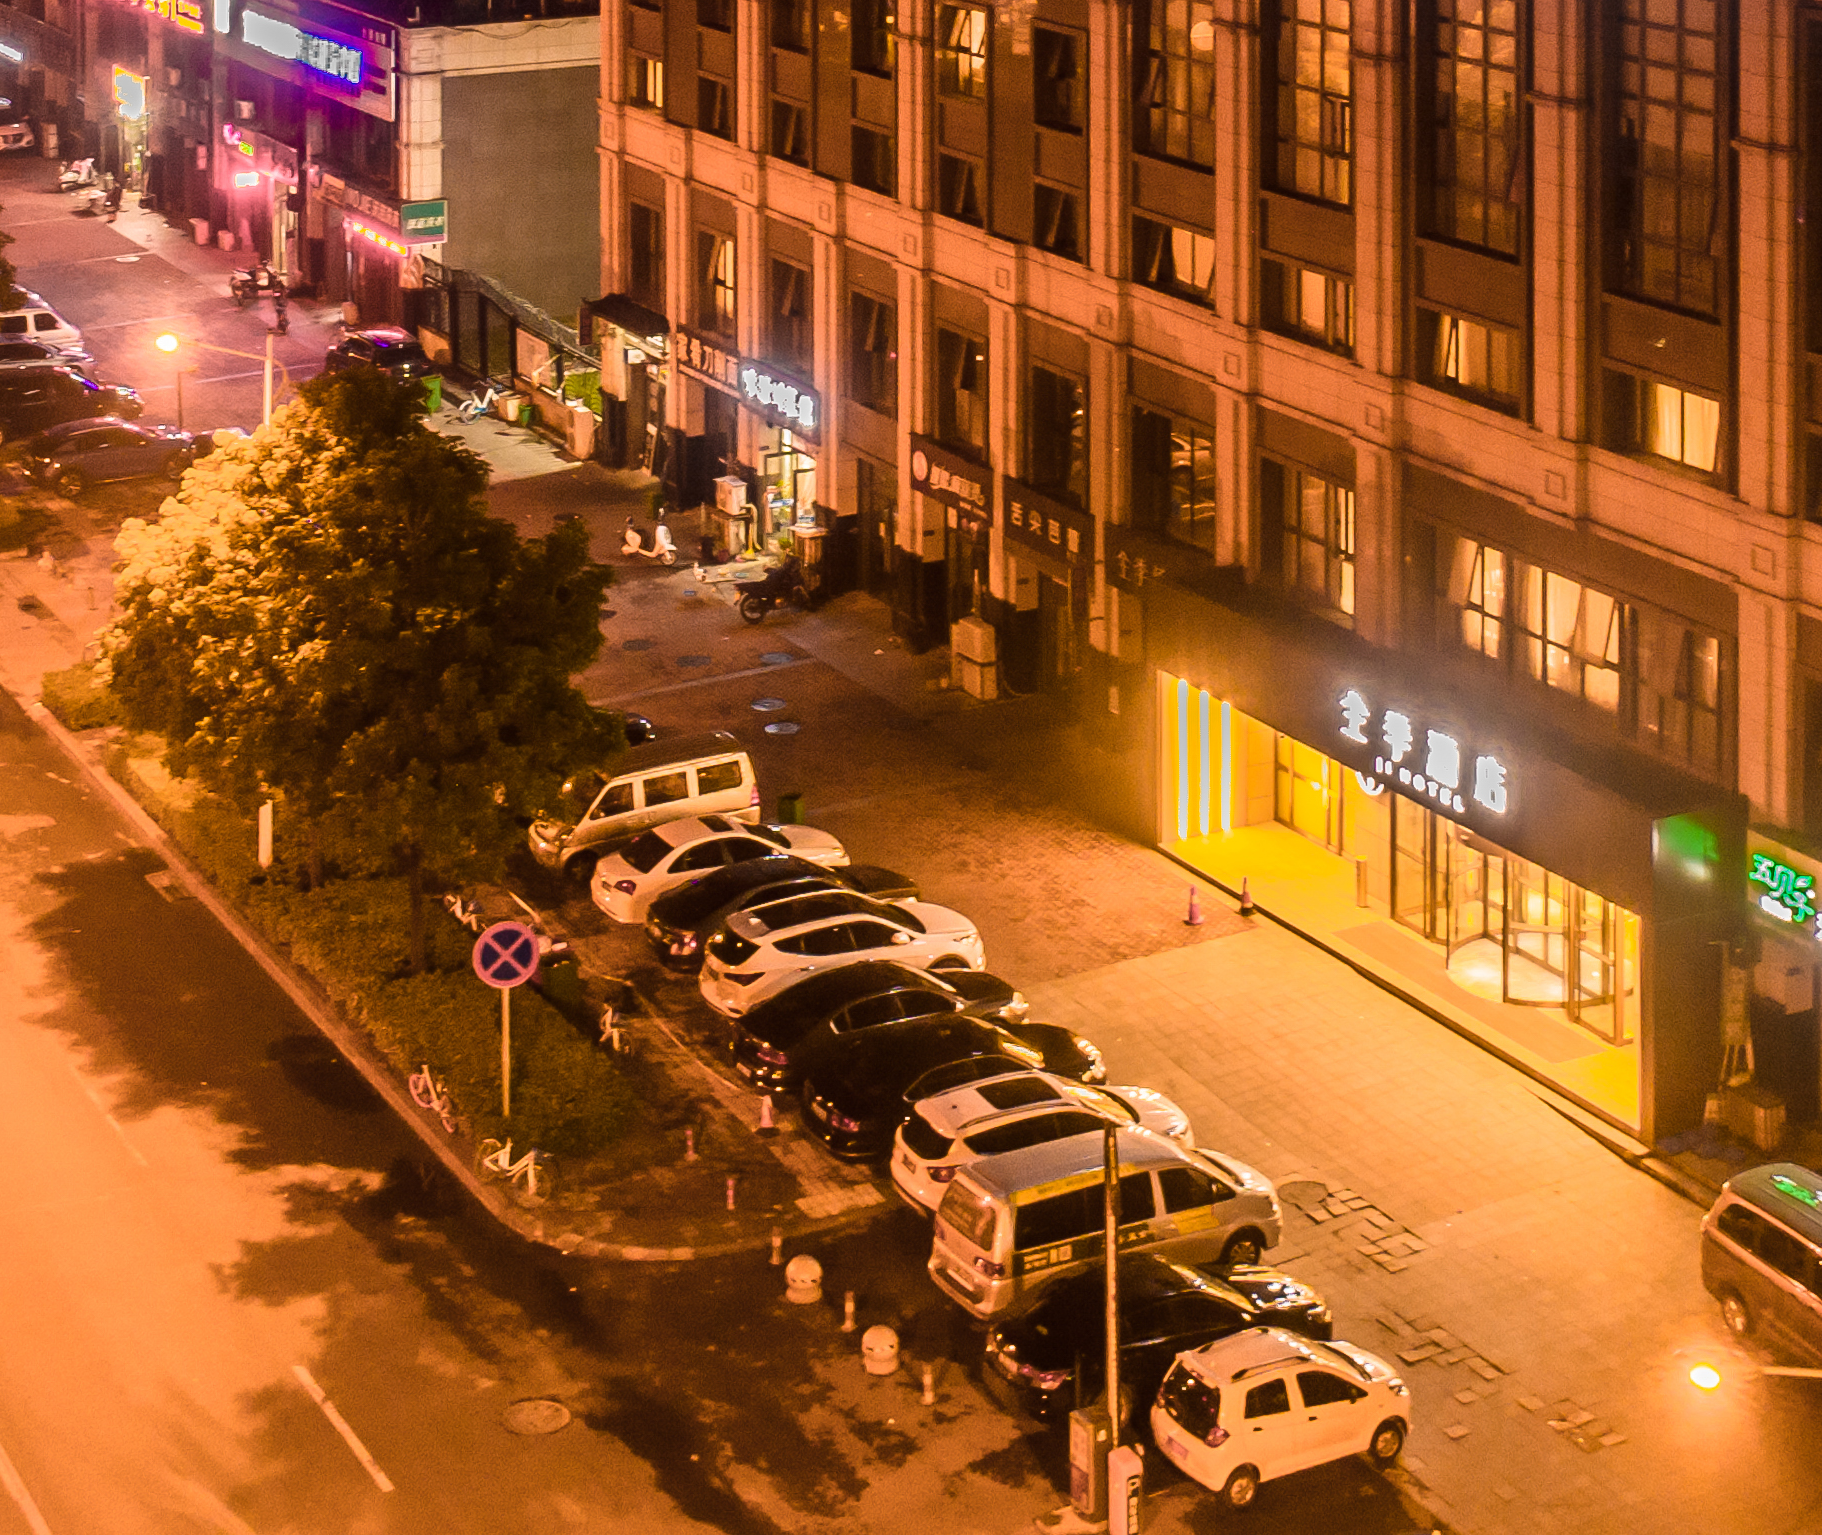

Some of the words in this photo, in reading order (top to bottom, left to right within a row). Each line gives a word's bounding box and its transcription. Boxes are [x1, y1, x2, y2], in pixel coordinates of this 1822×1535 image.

[1339, 690, 1507, 813] 全季酒店
[1399, 767, 1465, 813] HOTEL
[1748, 853, 1816, 922] 五贝子
